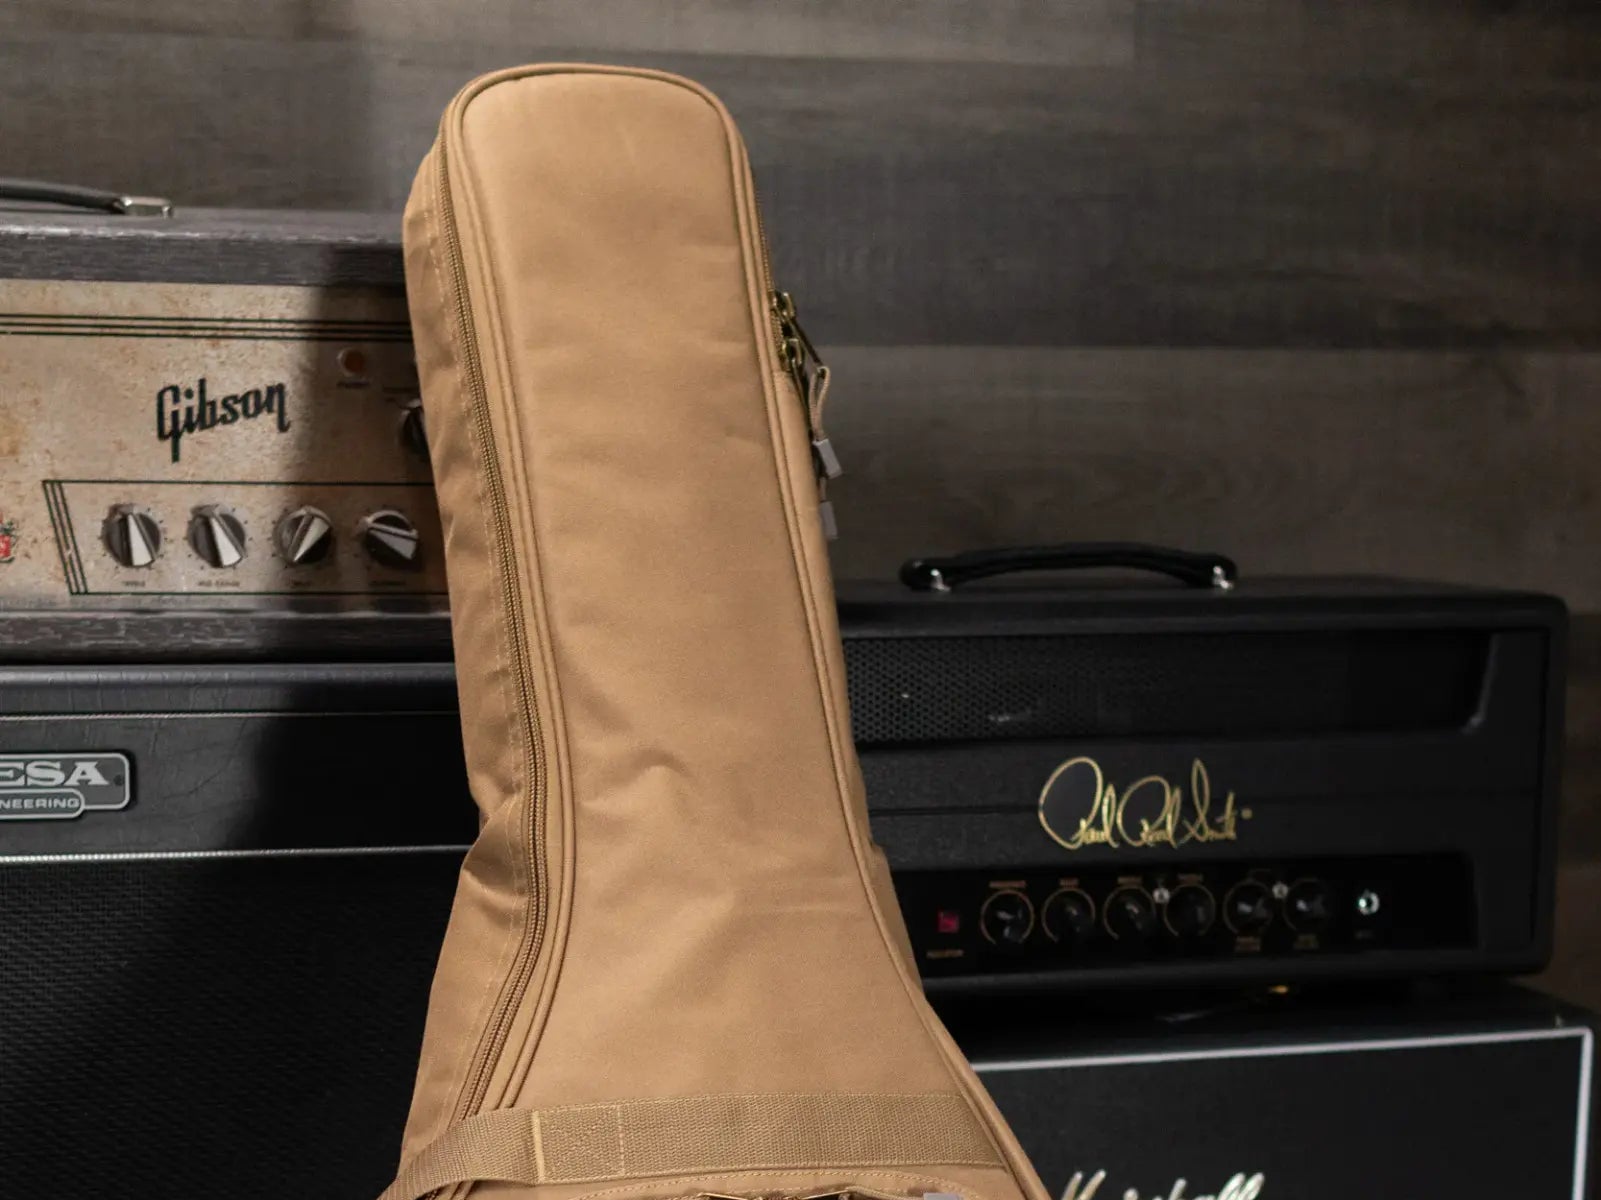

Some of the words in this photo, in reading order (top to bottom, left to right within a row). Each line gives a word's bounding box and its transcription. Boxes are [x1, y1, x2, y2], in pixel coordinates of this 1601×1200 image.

[156, 378, 290, 463] Gibson
[0, 761, 109, 786] ESA
[0, 798, 80, 809] NEERING
